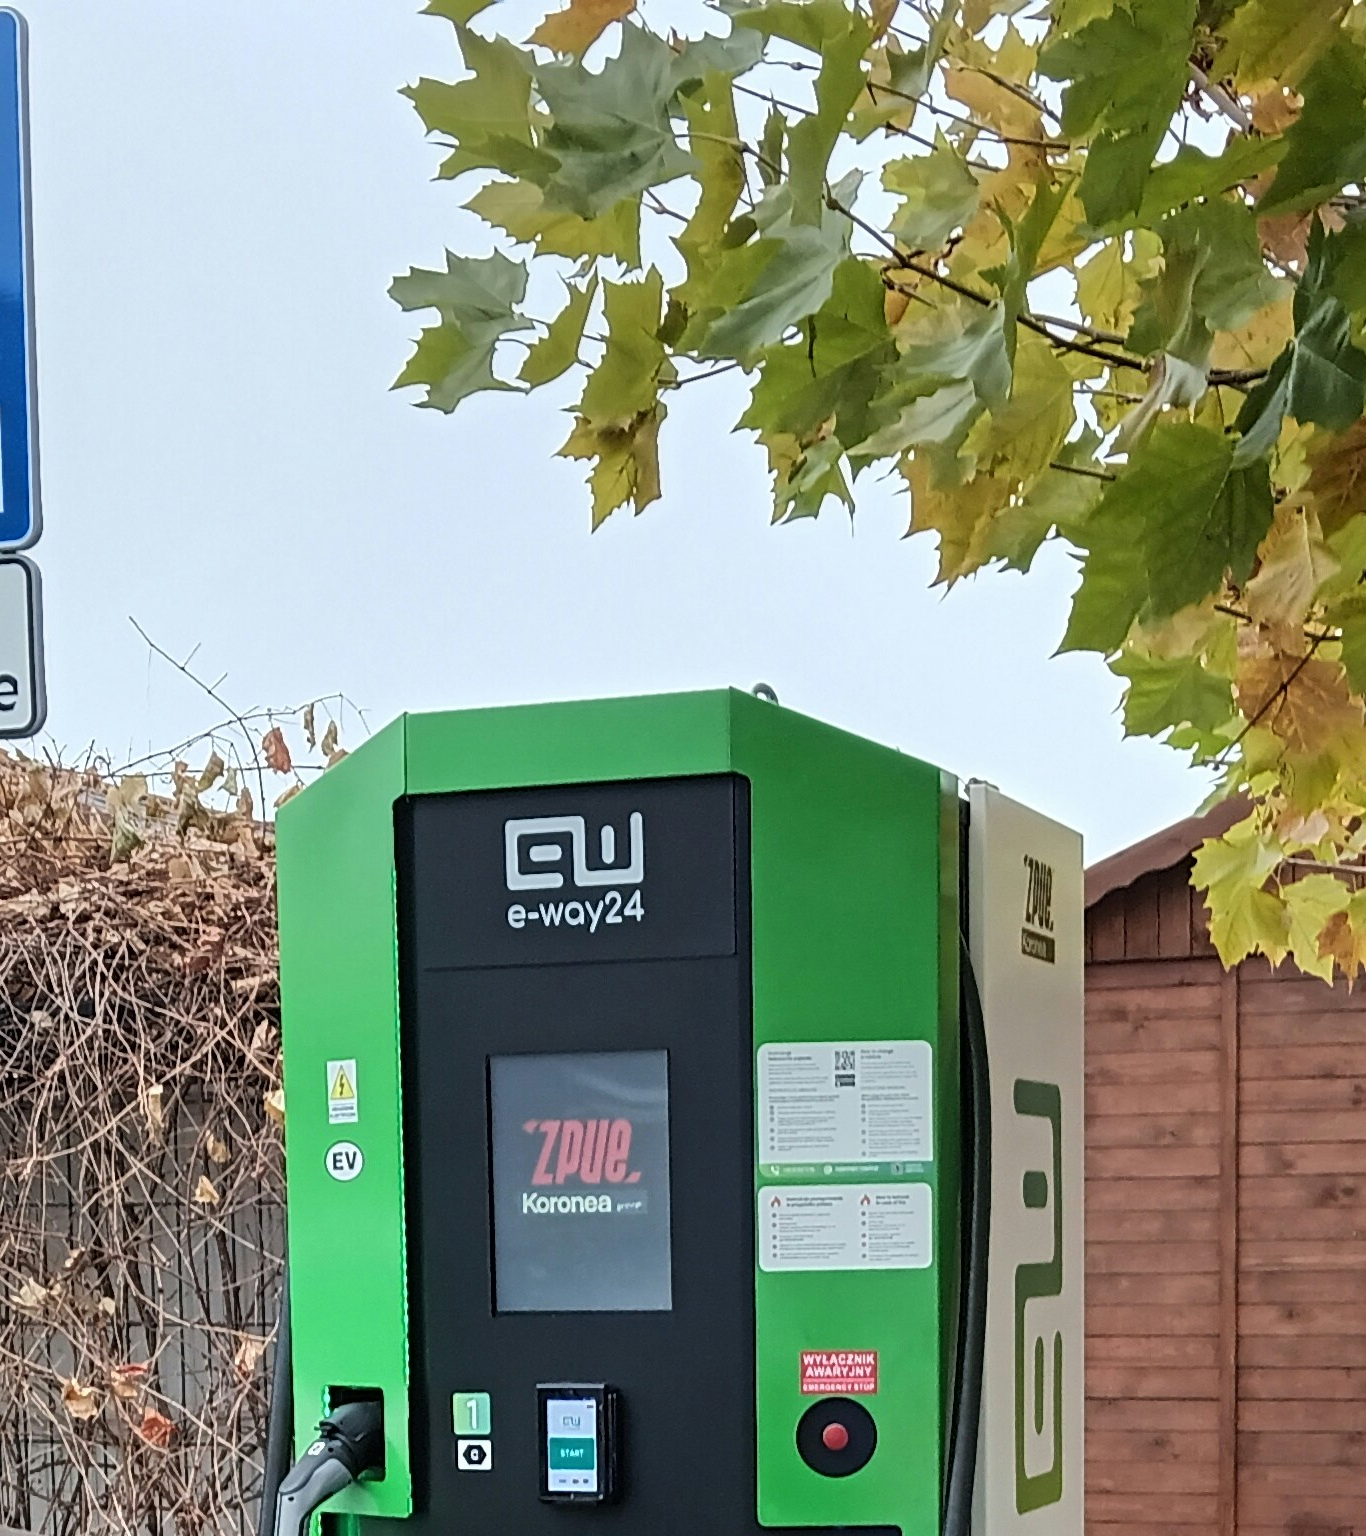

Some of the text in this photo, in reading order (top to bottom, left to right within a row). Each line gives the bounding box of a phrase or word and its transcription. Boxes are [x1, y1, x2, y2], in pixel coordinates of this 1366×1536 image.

[507, 889, 645, 933] e-way24
[333, 1151, 357, 1170] EV
[522, 1192, 612, 1214] Koronea
[805, 1366, 872, 1377] AWARYJNY
[466, 1399, 478, 1430] 1
[560, 1448, 584, 1458] START
